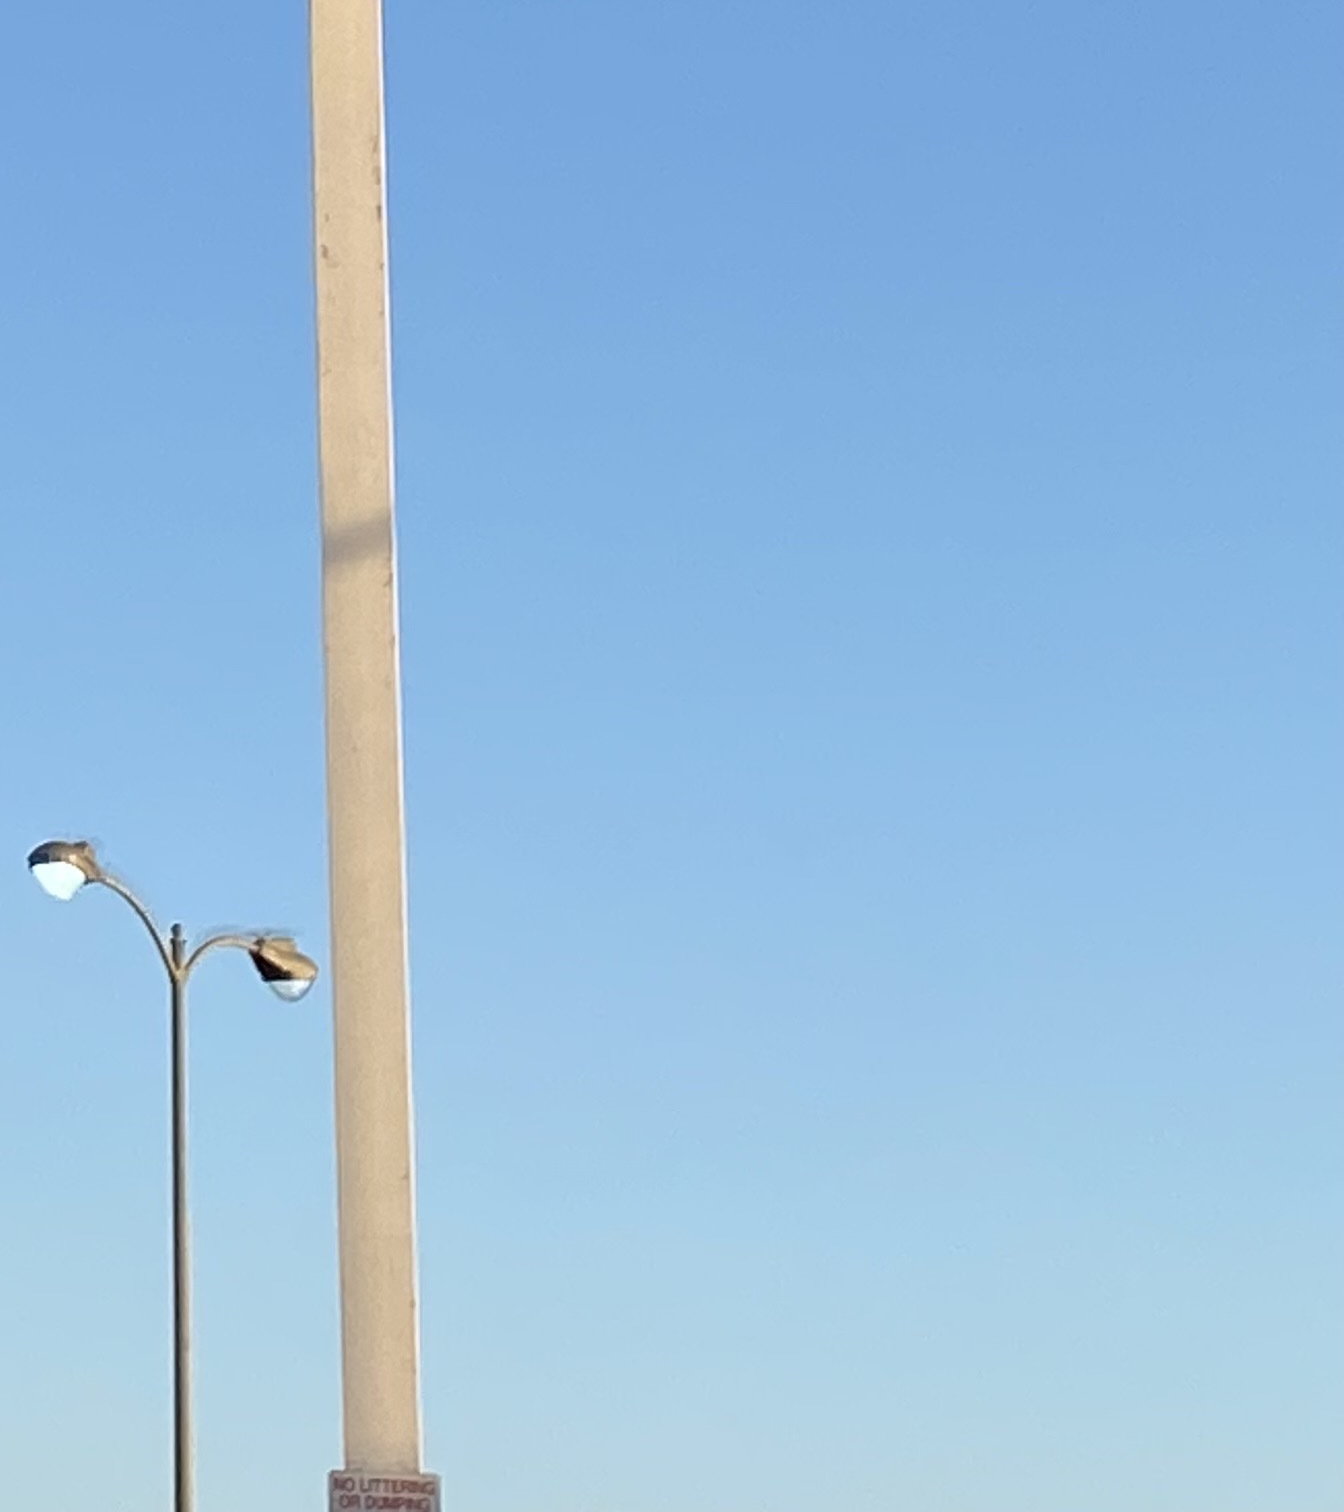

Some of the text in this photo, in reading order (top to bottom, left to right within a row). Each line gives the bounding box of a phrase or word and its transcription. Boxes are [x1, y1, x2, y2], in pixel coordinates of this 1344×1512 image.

[333, 1478, 435, 1495] NO LITTERING
[339, 1494, 431, 1510] OR DUMPING
